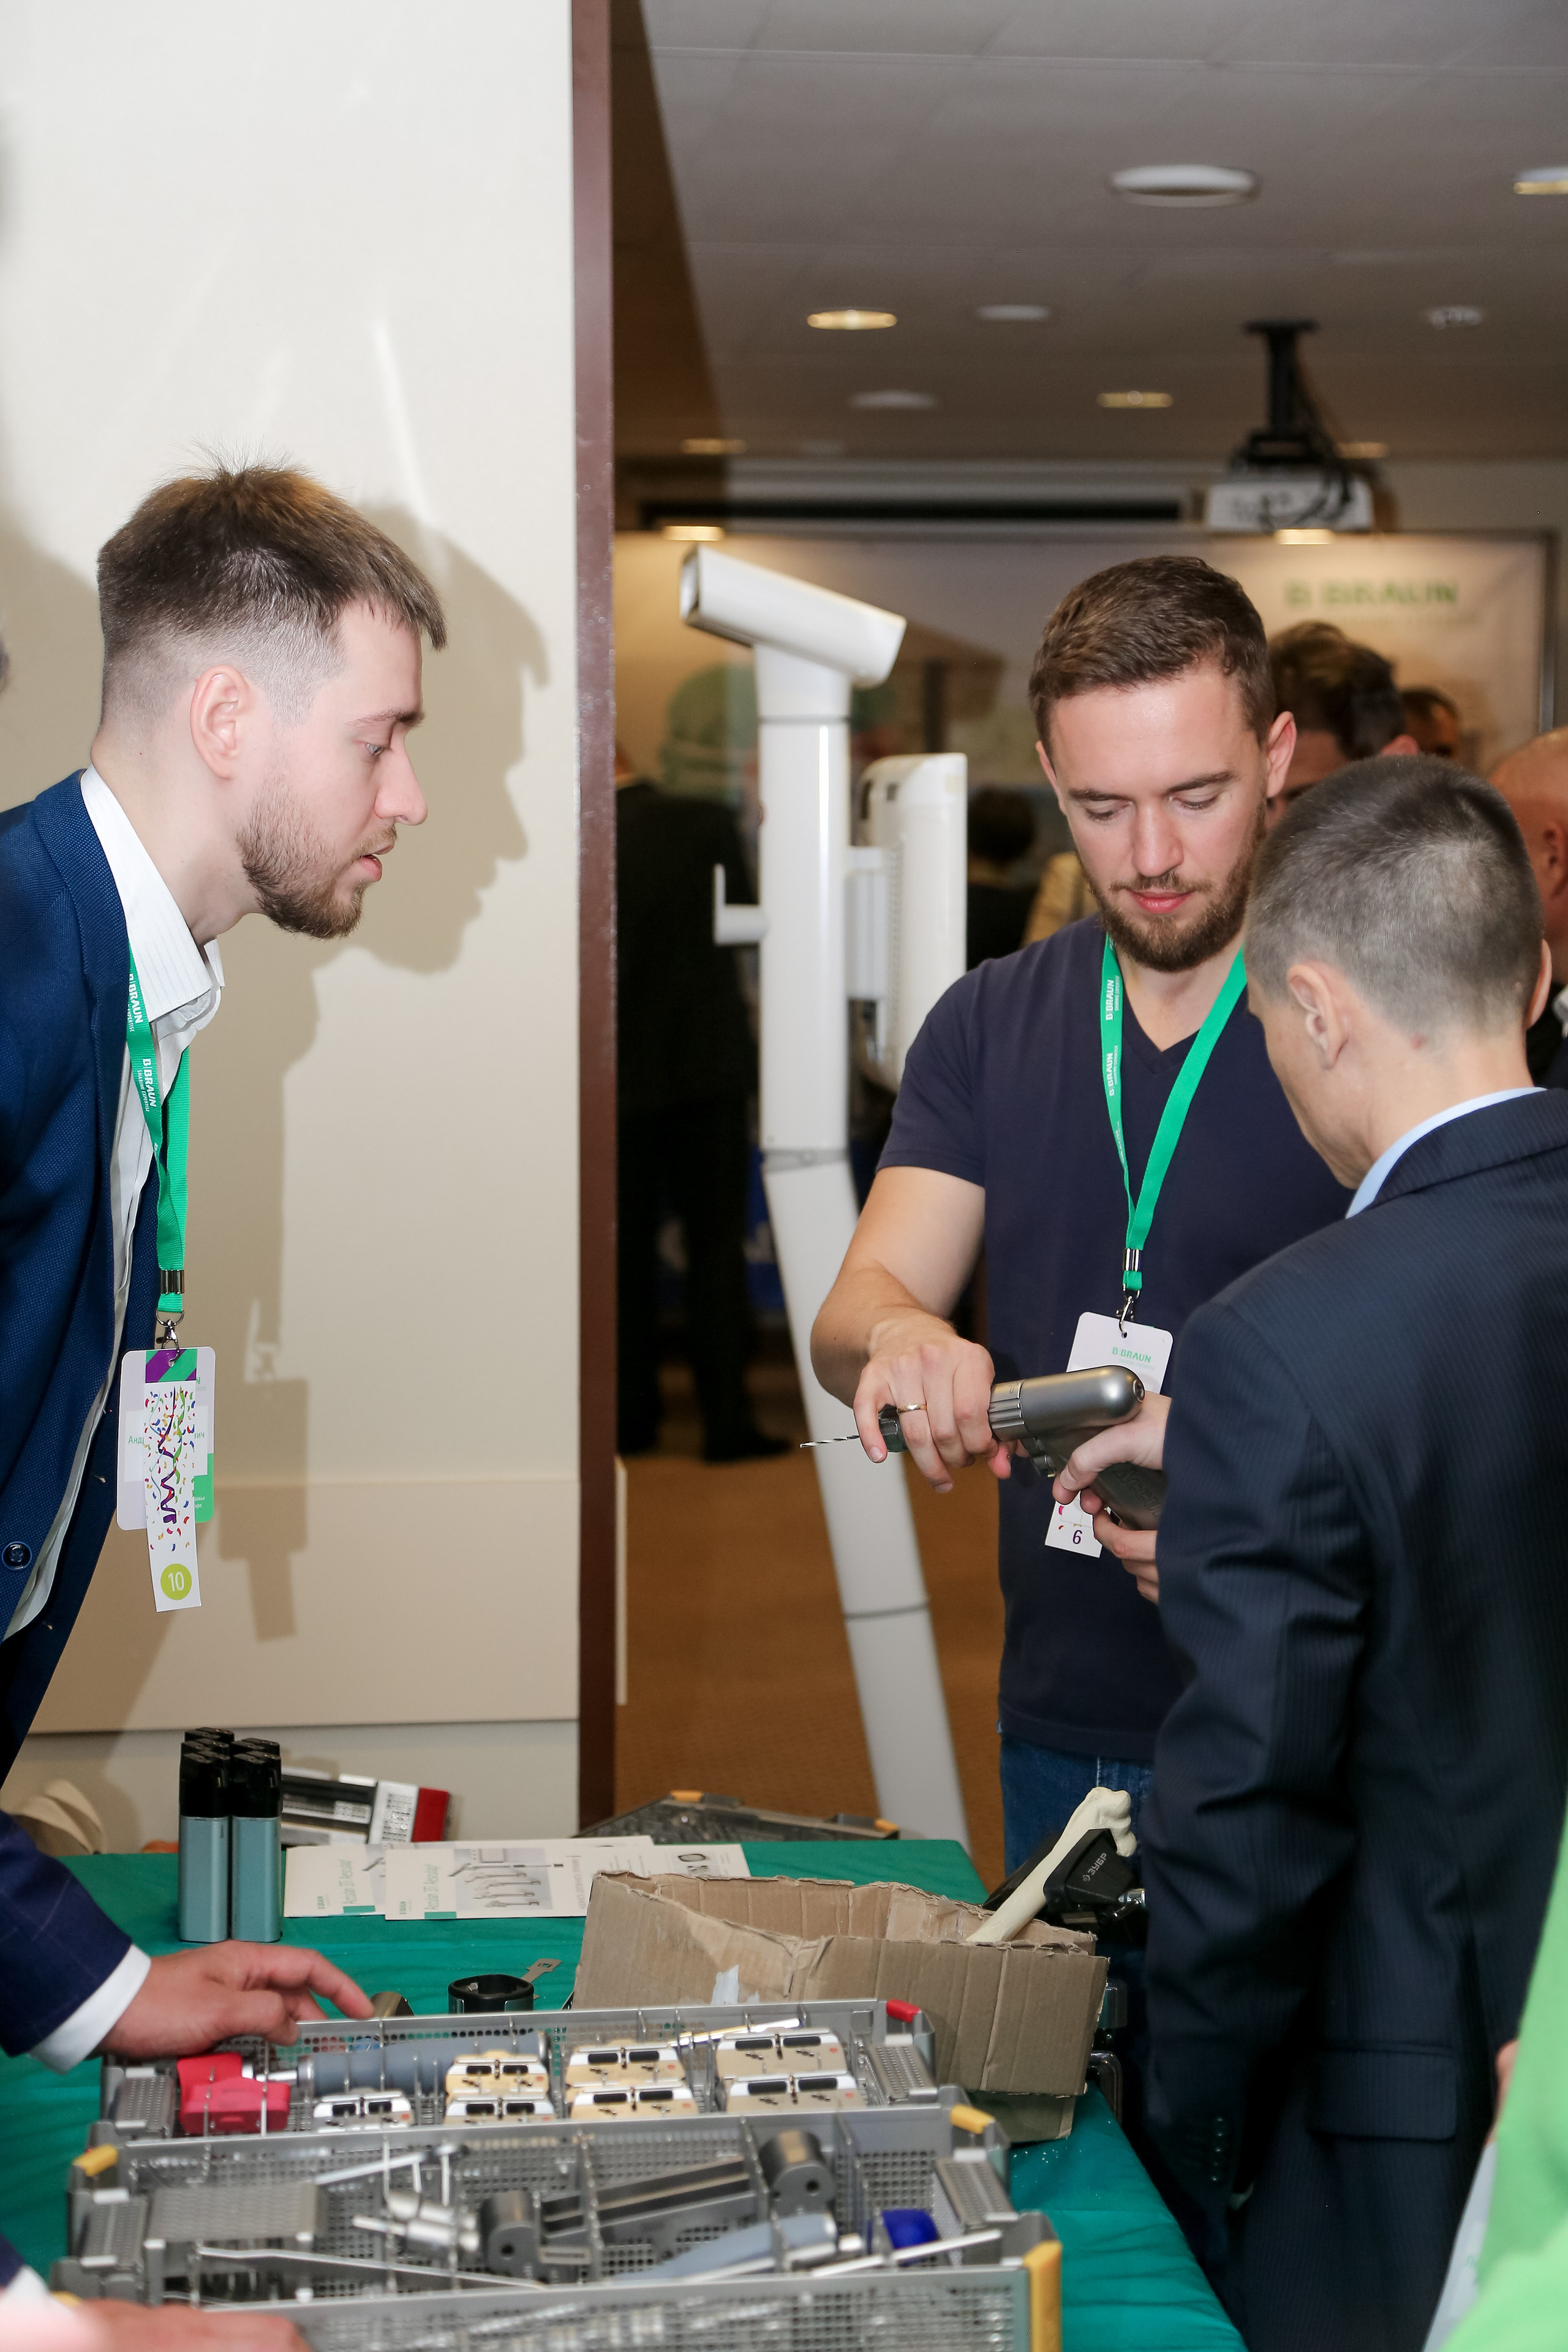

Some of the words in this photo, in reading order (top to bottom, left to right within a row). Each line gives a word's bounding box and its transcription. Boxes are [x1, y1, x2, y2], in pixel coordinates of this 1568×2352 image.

[143, 1069, 157, 1107] BRAUN
[141, 1090, 150, 1112] EXPERTISE
[1120, 1349, 1152, 1363] BRAUN
[1072, 1529, 1082, 1545] 6
[168, 1571, 184, 1592] 10
[1087, 1853, 1107, 1875] ЗУБР
